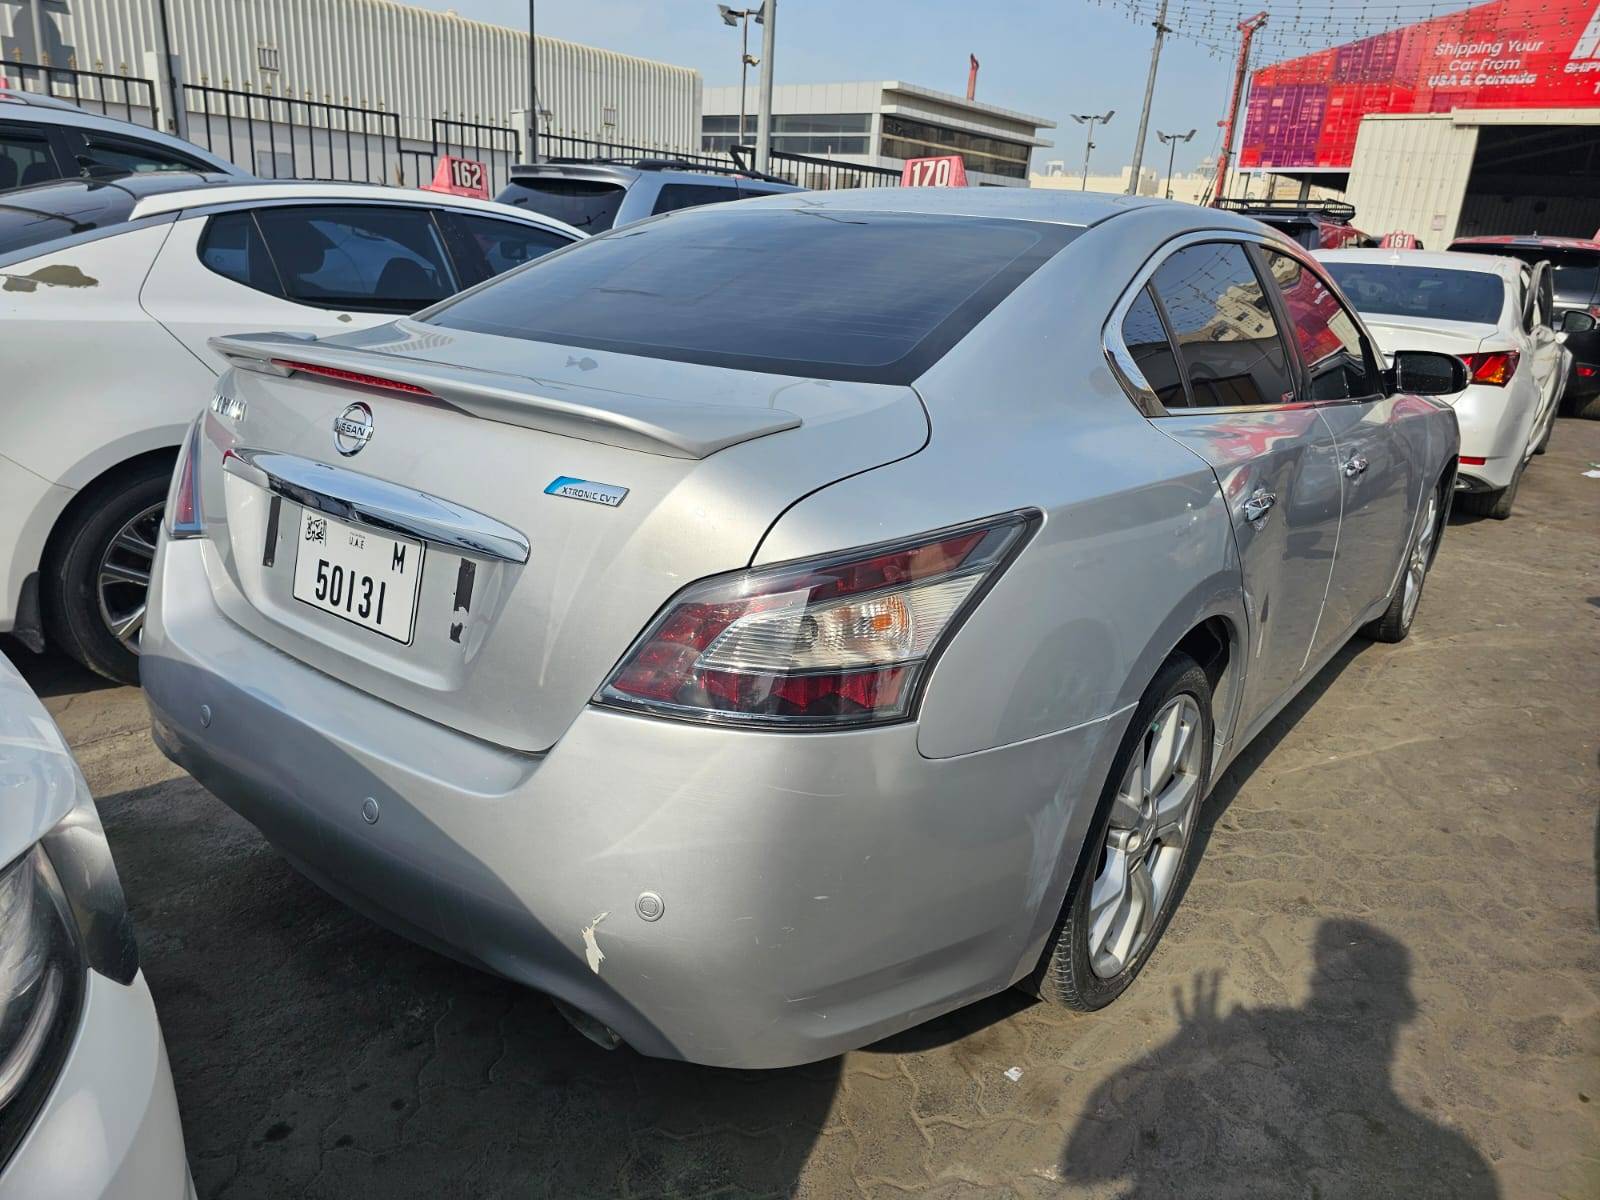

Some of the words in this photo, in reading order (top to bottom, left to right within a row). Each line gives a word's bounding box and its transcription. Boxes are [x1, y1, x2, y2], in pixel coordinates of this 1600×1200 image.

[1435, 41, 1502, 57] Shipping
[1508, 40, 1544, 52] Your
[1449, 59, 1475, 72] Car
[1480, 58, 1520, 71] From
[1428, 75, 1457, 87] USA
[1460, 75, 1471, 86] &
[1474, 72, 1537, 86] Canada
[452, 160, 482, 190] 162
[913, 160, 951, 188] 170
[1390, 234, 1409, 249] 161
[562, 486, 598, 500] XTRONIC
[599, 493, 618, 504] CVT
[391, 541, 406, 574] M
[315, 558, 386, 625] 50131
